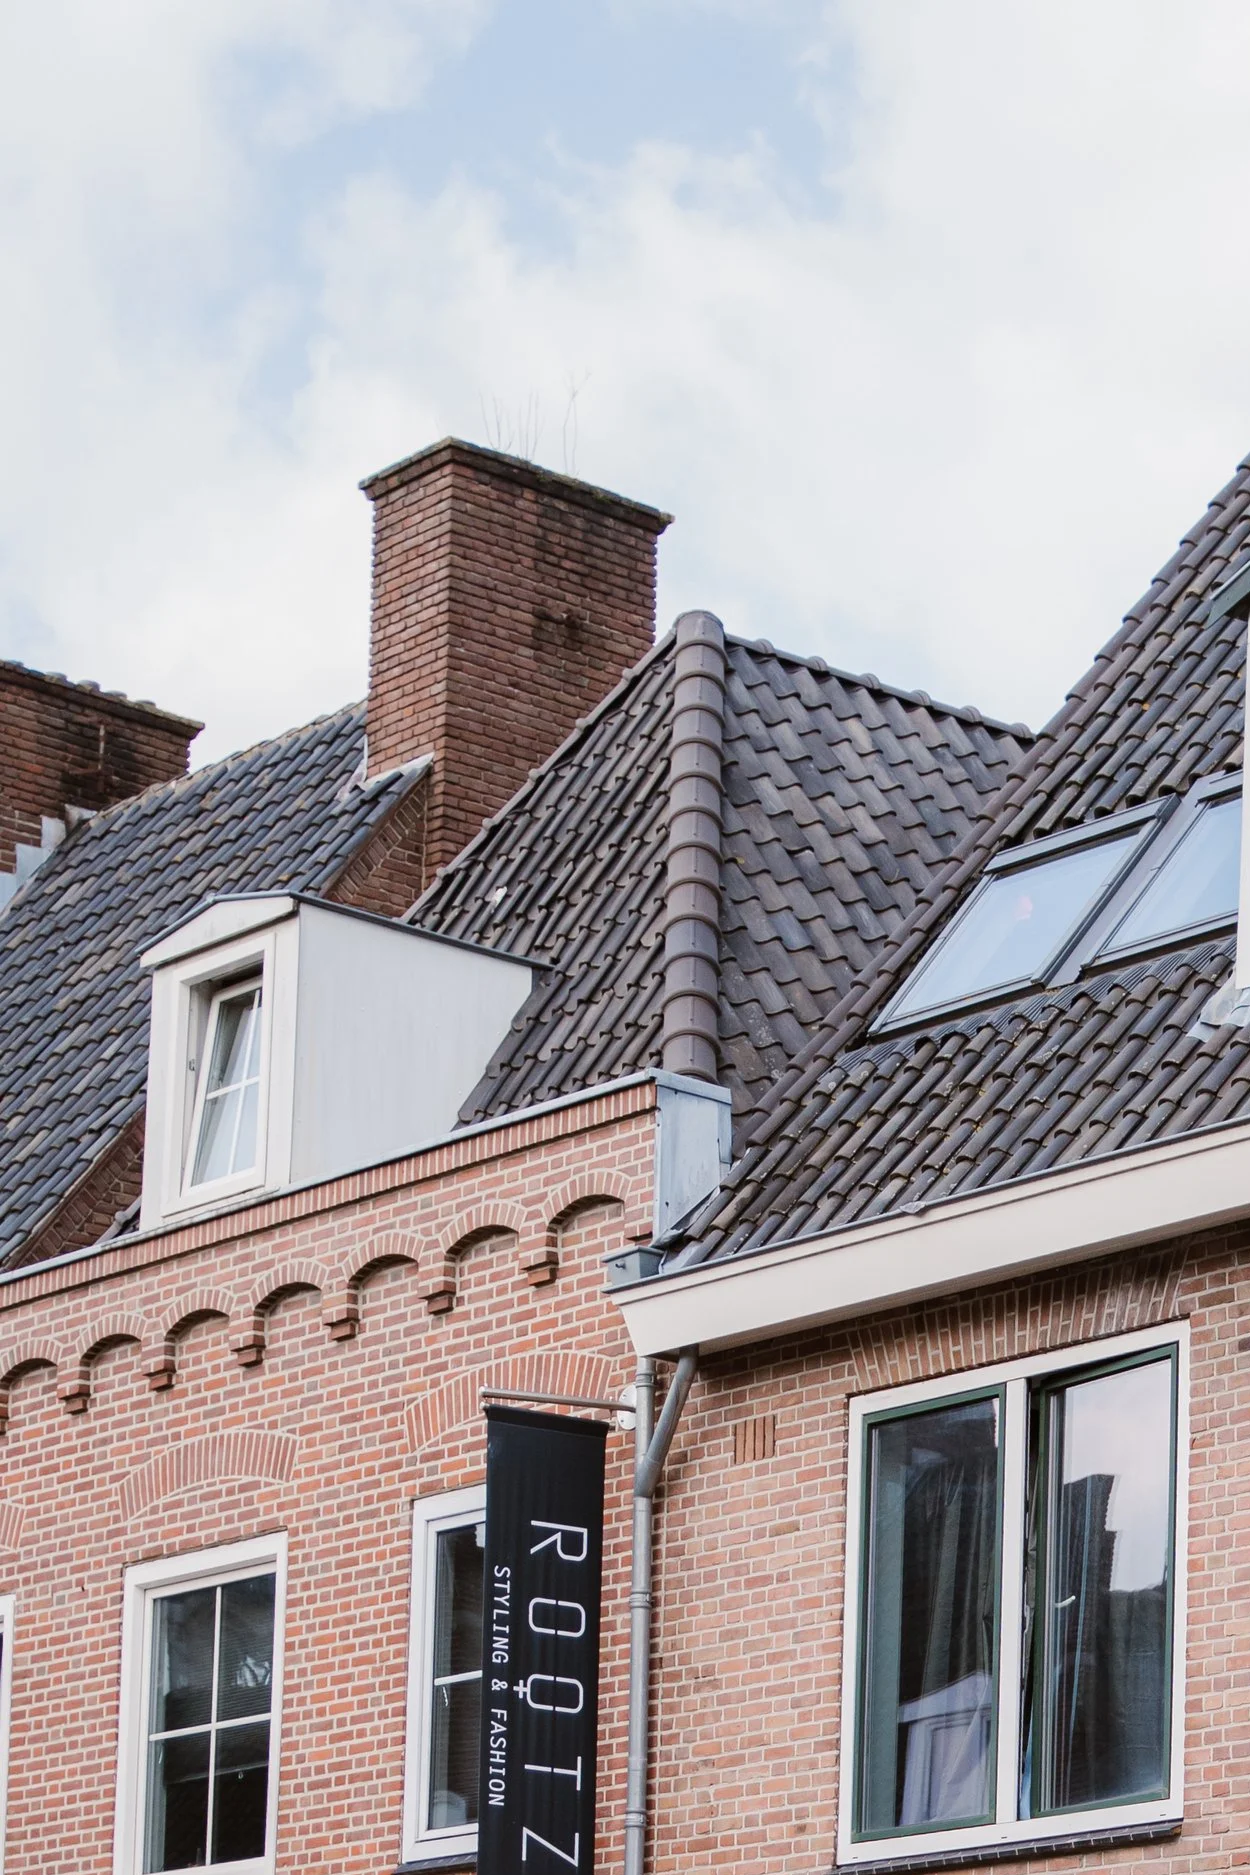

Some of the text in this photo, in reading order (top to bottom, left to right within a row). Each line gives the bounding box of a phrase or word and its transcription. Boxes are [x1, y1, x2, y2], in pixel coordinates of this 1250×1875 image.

[487, 1564, 512, 1808] STYLING & FASHION
